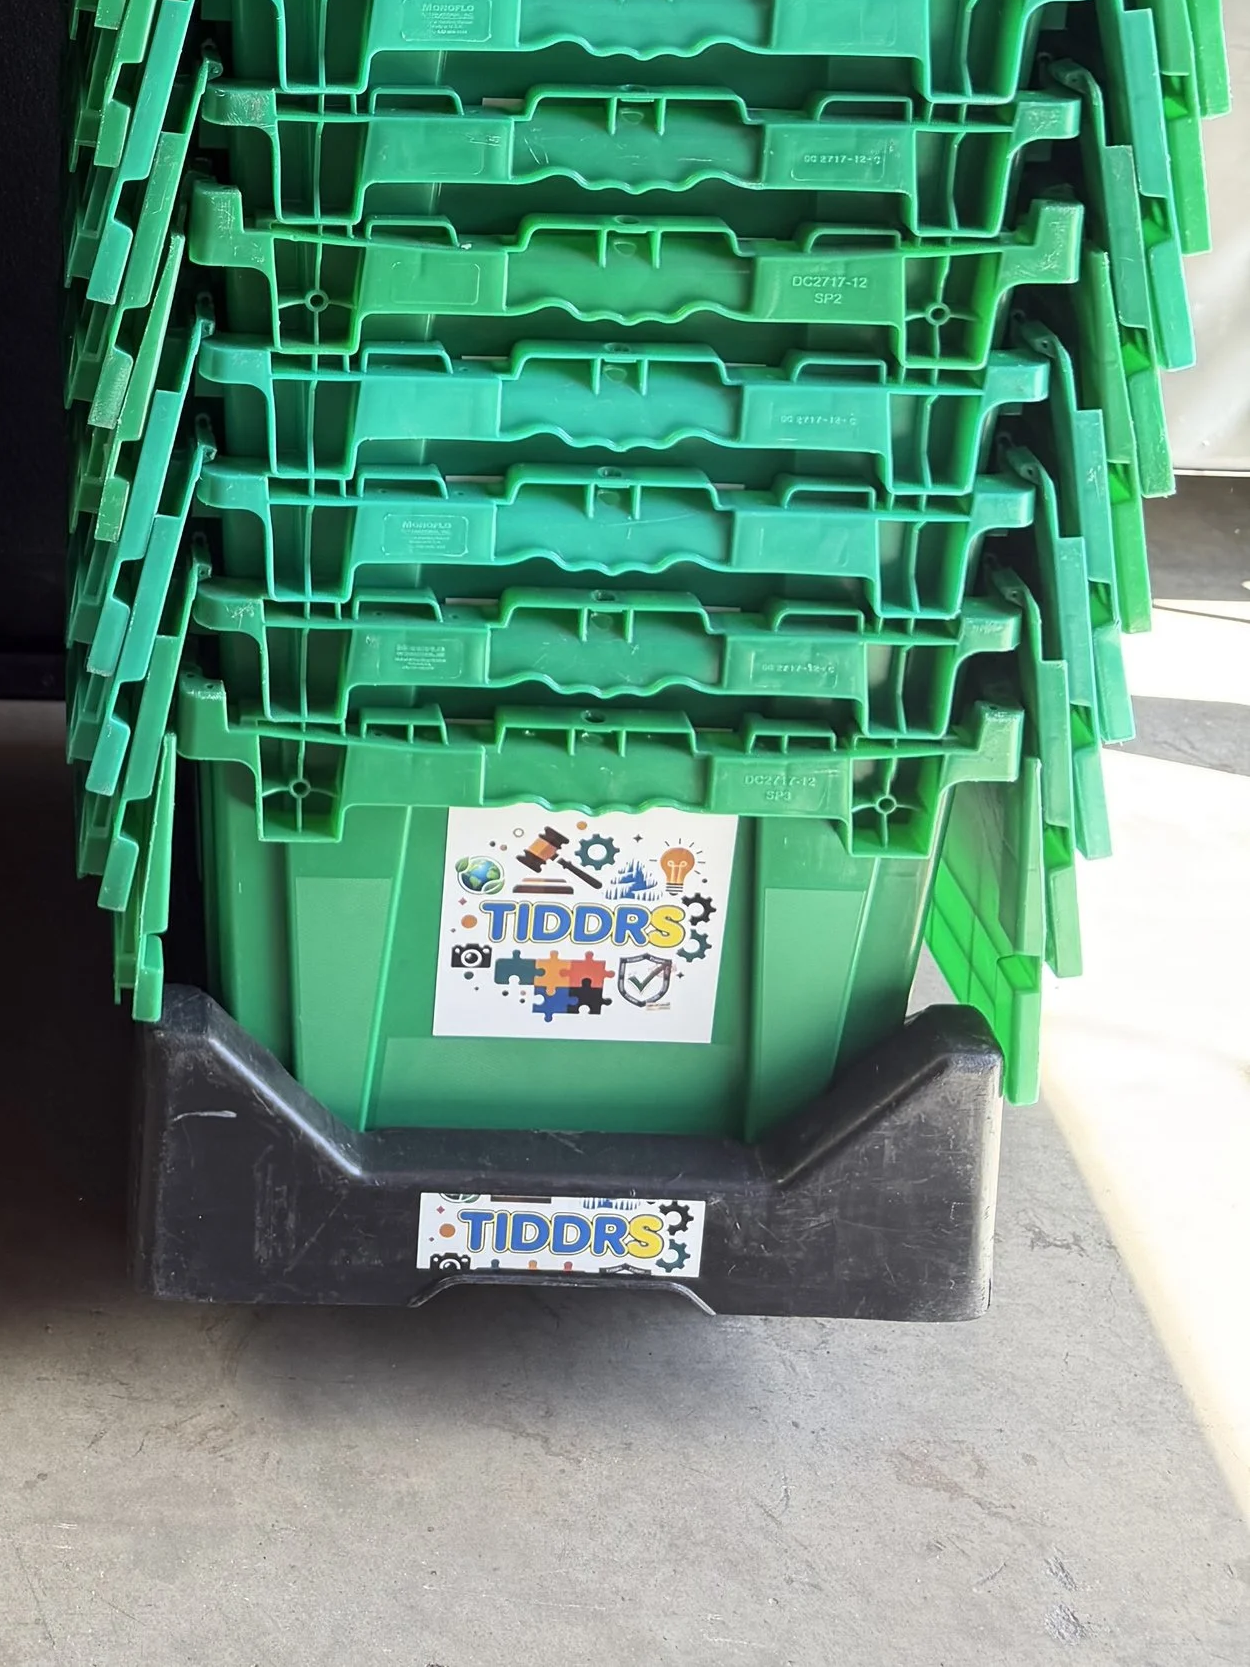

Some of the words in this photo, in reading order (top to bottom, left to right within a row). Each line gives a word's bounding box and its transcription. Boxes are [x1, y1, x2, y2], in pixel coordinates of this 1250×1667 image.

[792, 276, 868, 289] DC2717-12
[814, 292, 842, 305] SP2
[744, 774, 816, 788] DC2717-12
[765, 790, 792, 801] SP3
[479, 900, 686, 948] TIDDRS
[457, 1209, 665, 1259] TIDDRS
